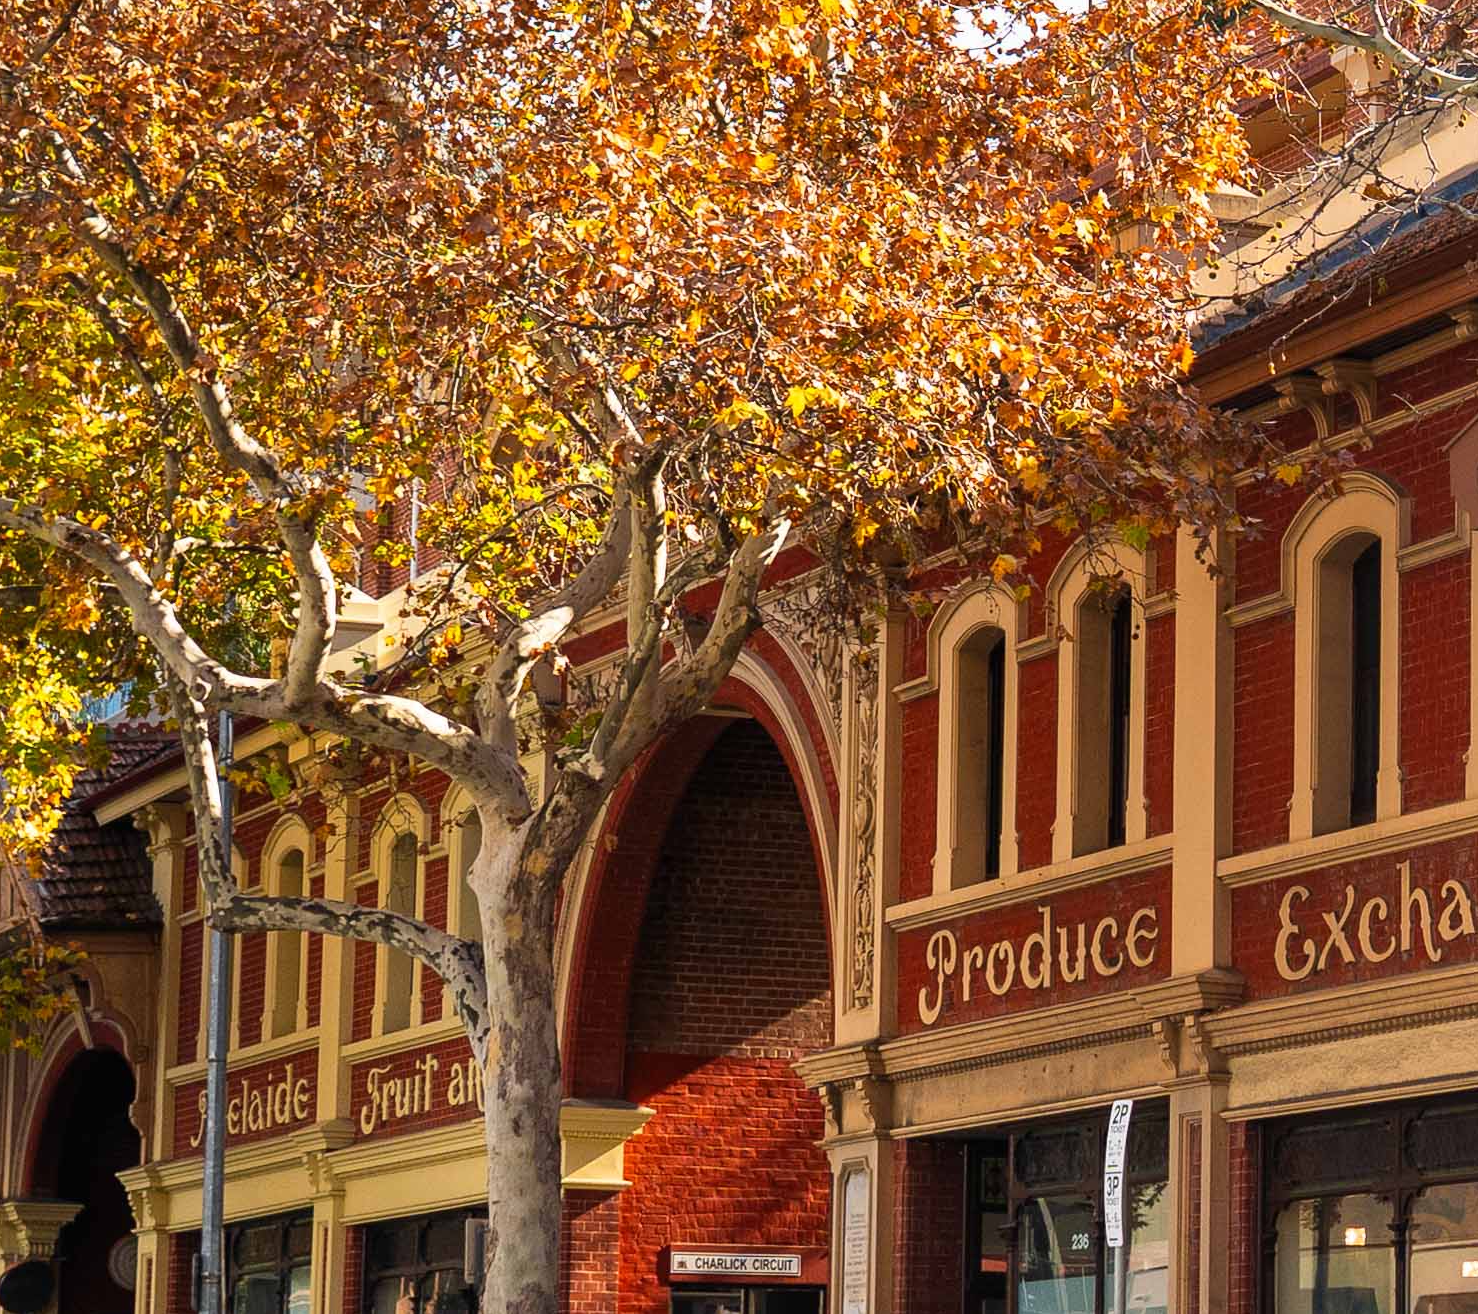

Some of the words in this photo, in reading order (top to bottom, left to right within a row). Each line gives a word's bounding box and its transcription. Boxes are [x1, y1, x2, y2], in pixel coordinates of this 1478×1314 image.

[918, 905, 1159, 1026] Produce
[190, 1063, 310, 1148] elaide
[361, 1052, 439, 1135] Fruit
[448, 1056, 486, 1113] an
[1112, 1104, 1129, 1124] 2P
[1106, 1176, 1120, 1197] 3P
[1072, 1233, 1090, 1250] 236
[694, 1257, 748, 1271] CHARLICK
[752, 1258, 794, 1271] CIRCUIT
